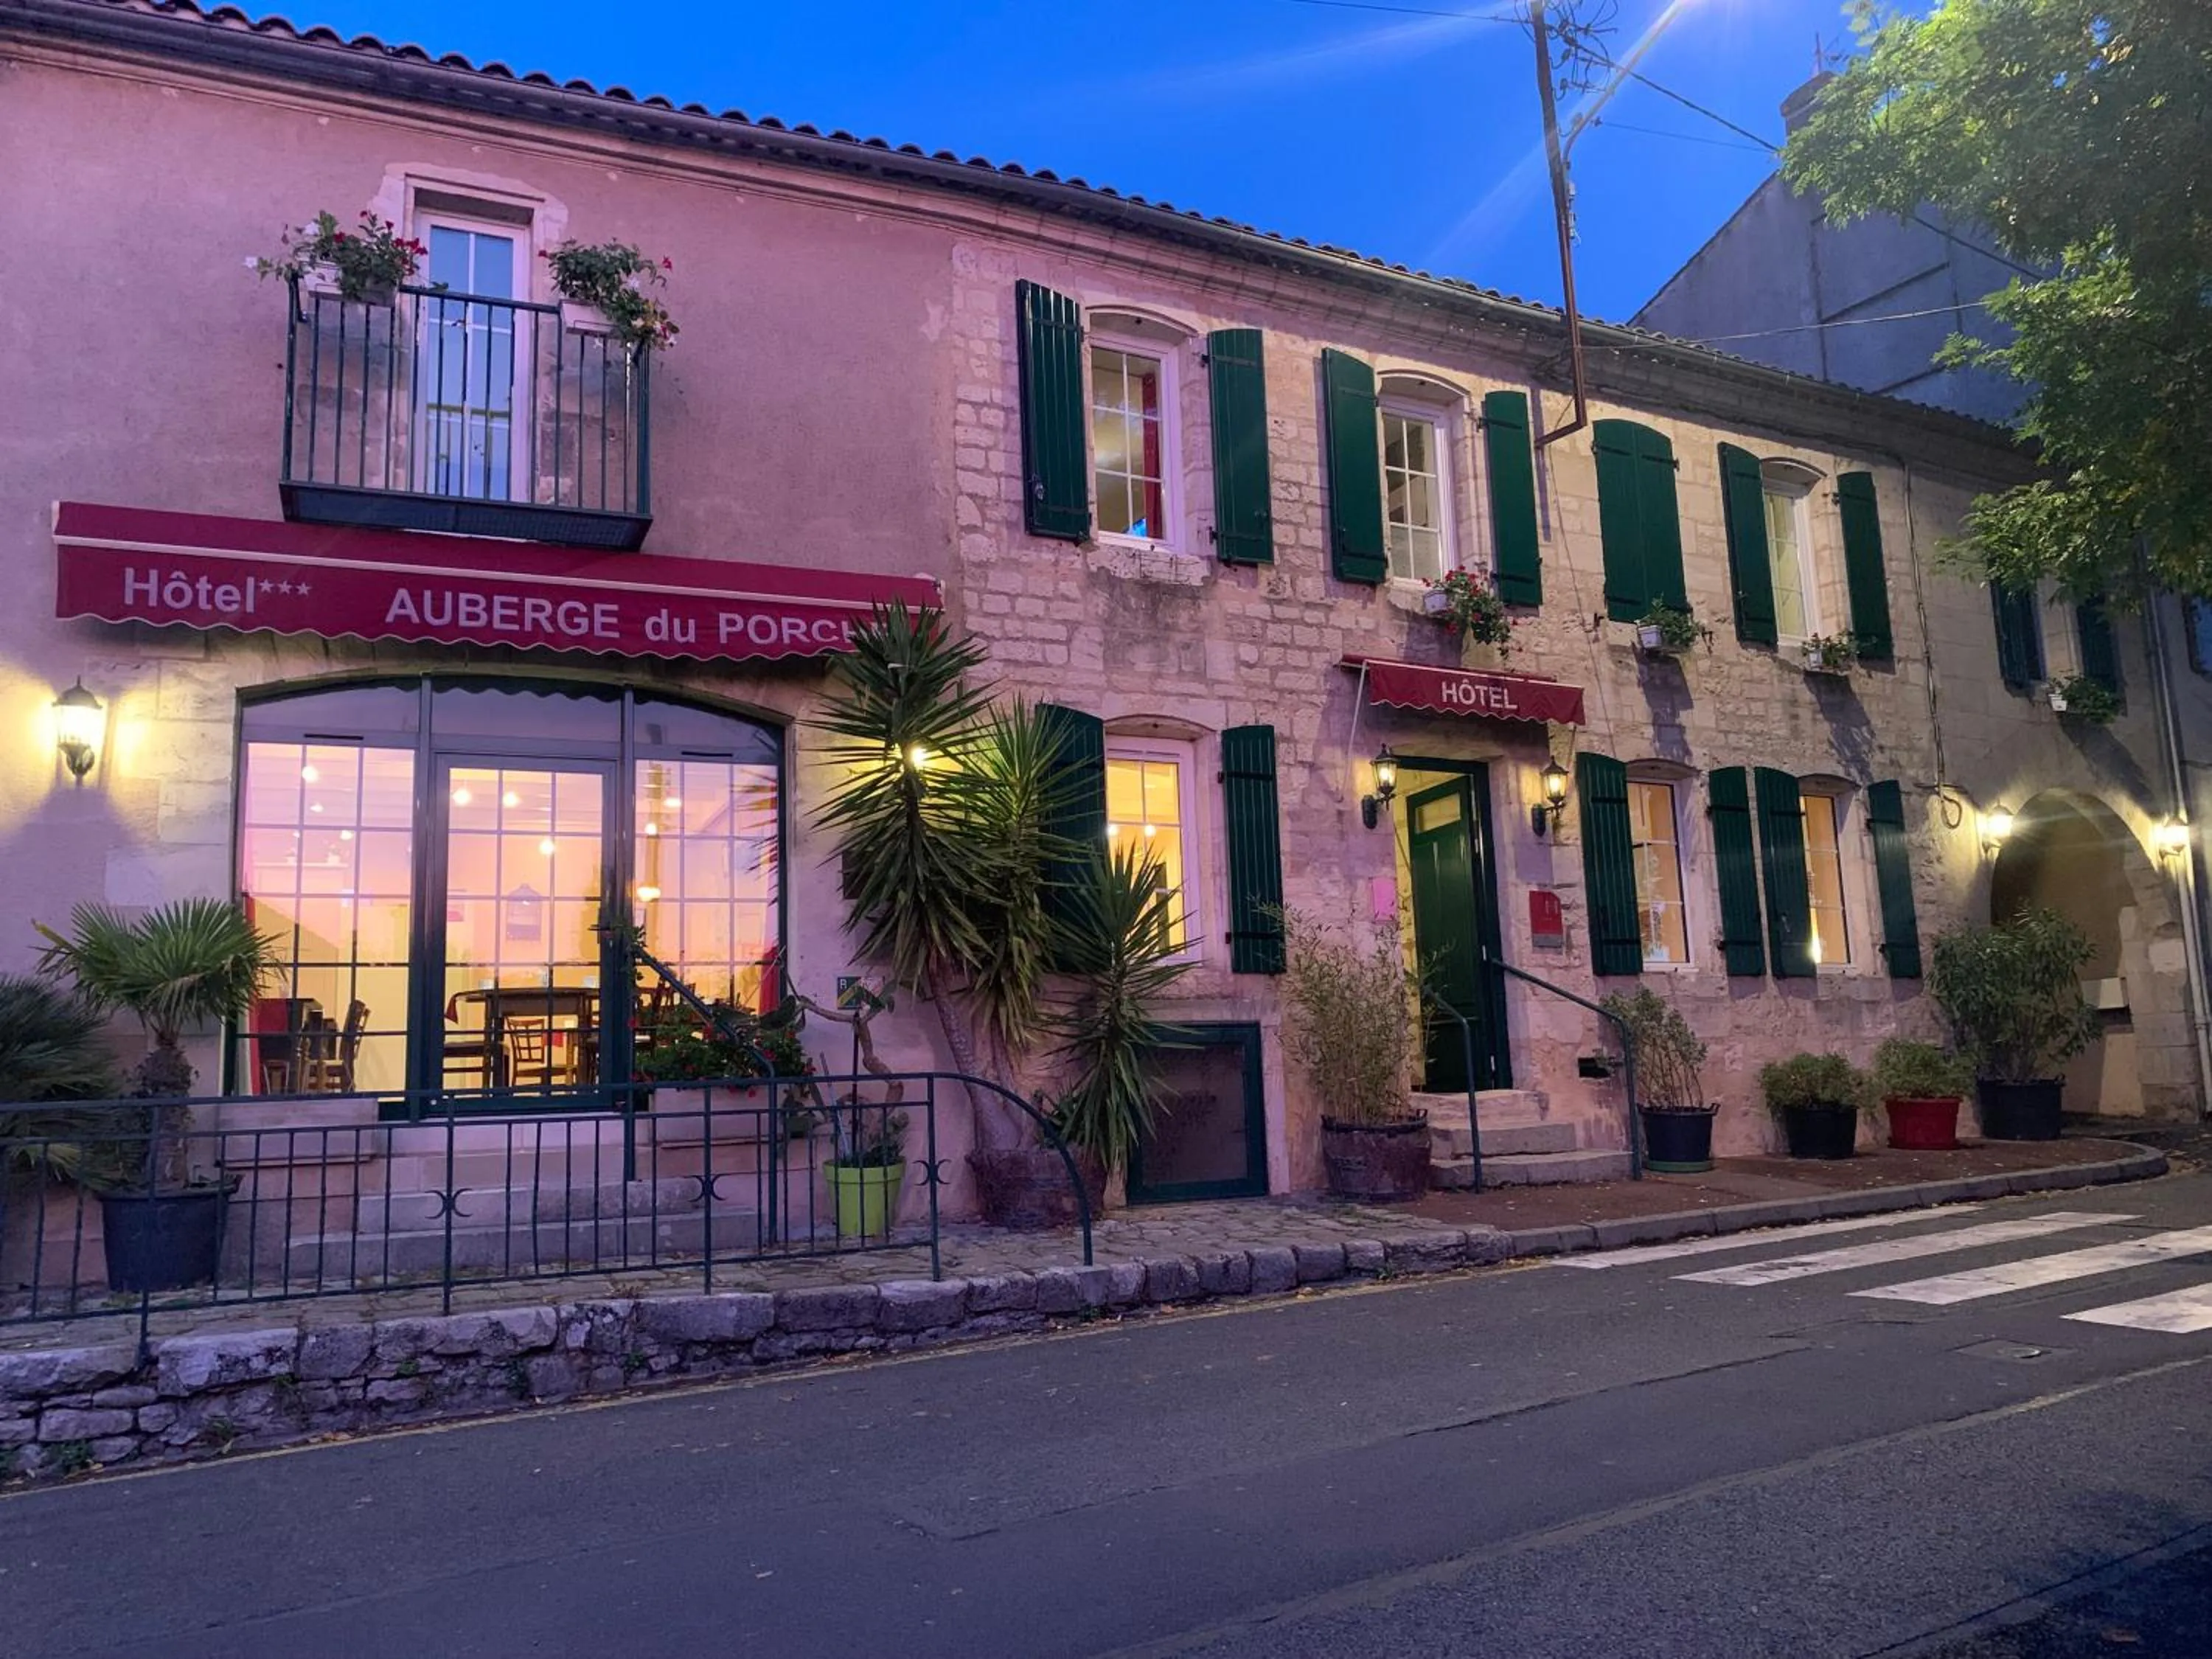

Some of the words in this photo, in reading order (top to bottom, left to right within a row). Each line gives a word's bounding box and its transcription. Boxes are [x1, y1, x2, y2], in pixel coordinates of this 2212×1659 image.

[123, 566, 255, 613] Hôtel
[385, 588, 620, 639] AUBERGE
[644, 609, 696, 644] du
[719, 612, 888, 646] PORCH
[1441, 678, 1518, 709] HÔTEL
